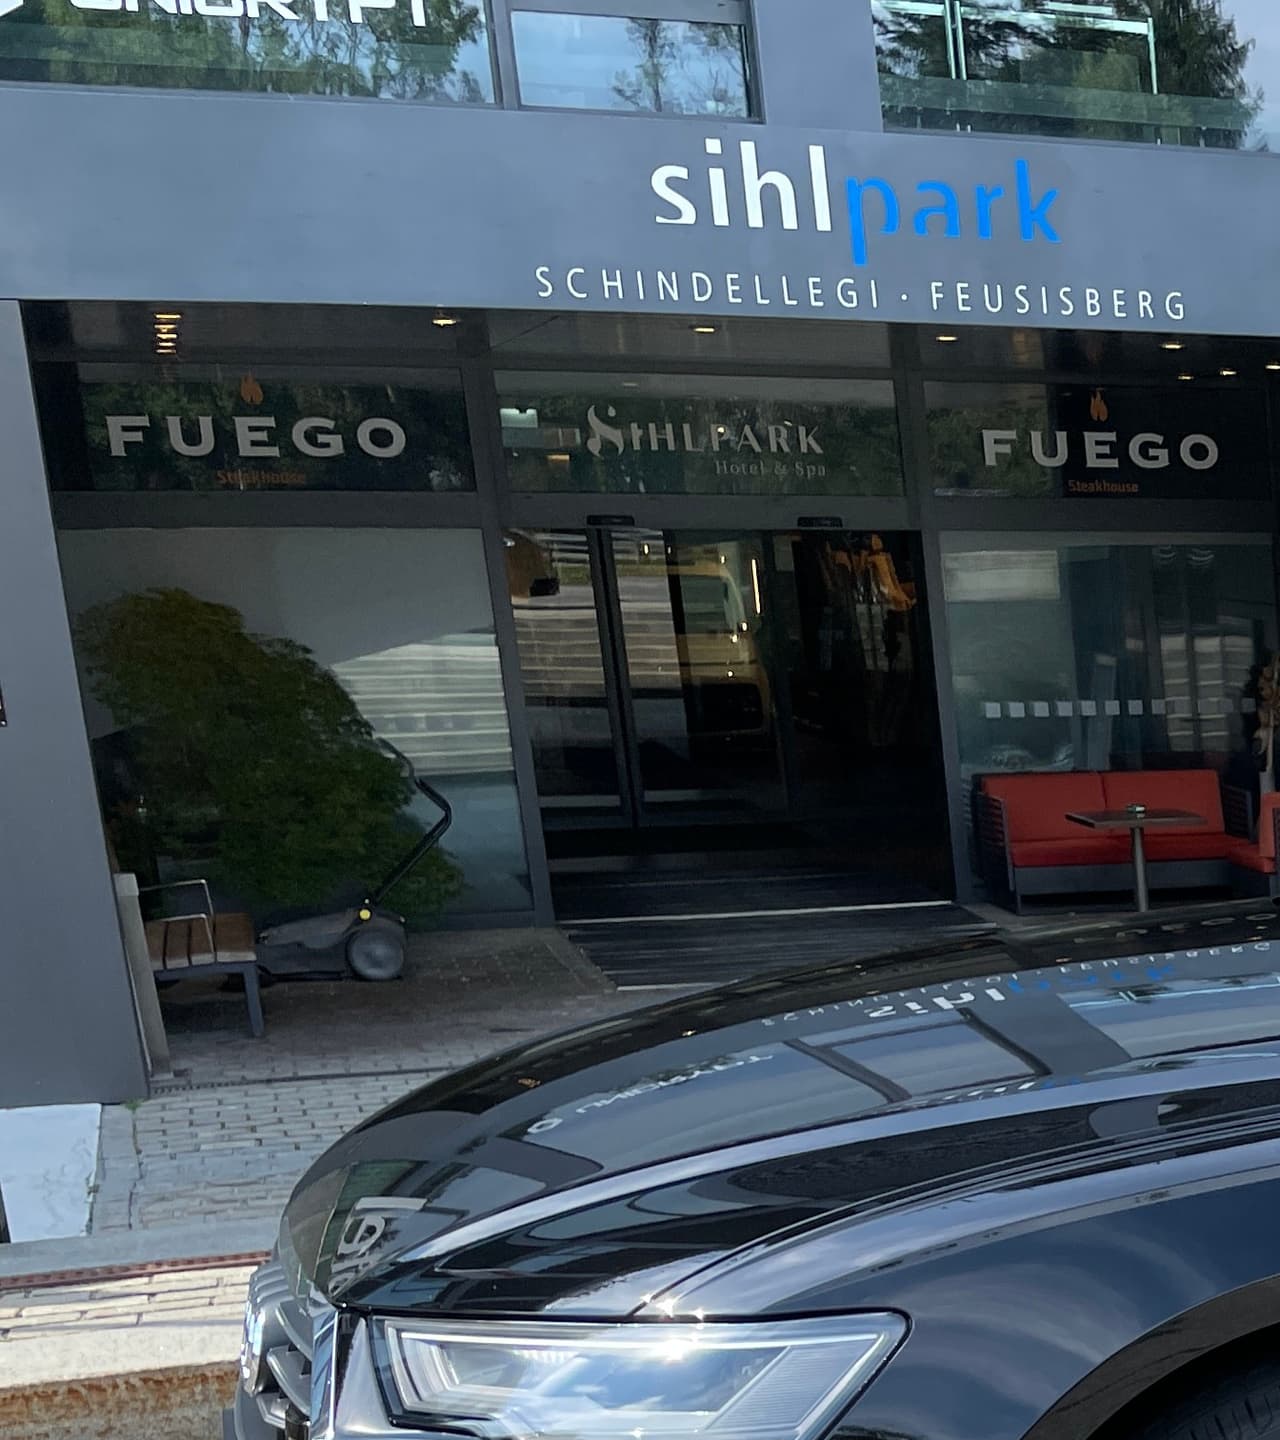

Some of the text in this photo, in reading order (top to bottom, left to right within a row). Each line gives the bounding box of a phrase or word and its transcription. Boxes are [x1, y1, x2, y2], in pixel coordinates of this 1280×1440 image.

[649, 137, 1062, 266] sihlpark
[535, 265, 1186, 322] SCHINDELLEGI FEUSISBERG
[104, 415, 407, 459] FUEGO
[981, 428, 1219, 471] FUEGO
[716, 460, 765, 476] Hotel
[1067, 479, 1140, 494] Steakhouse
